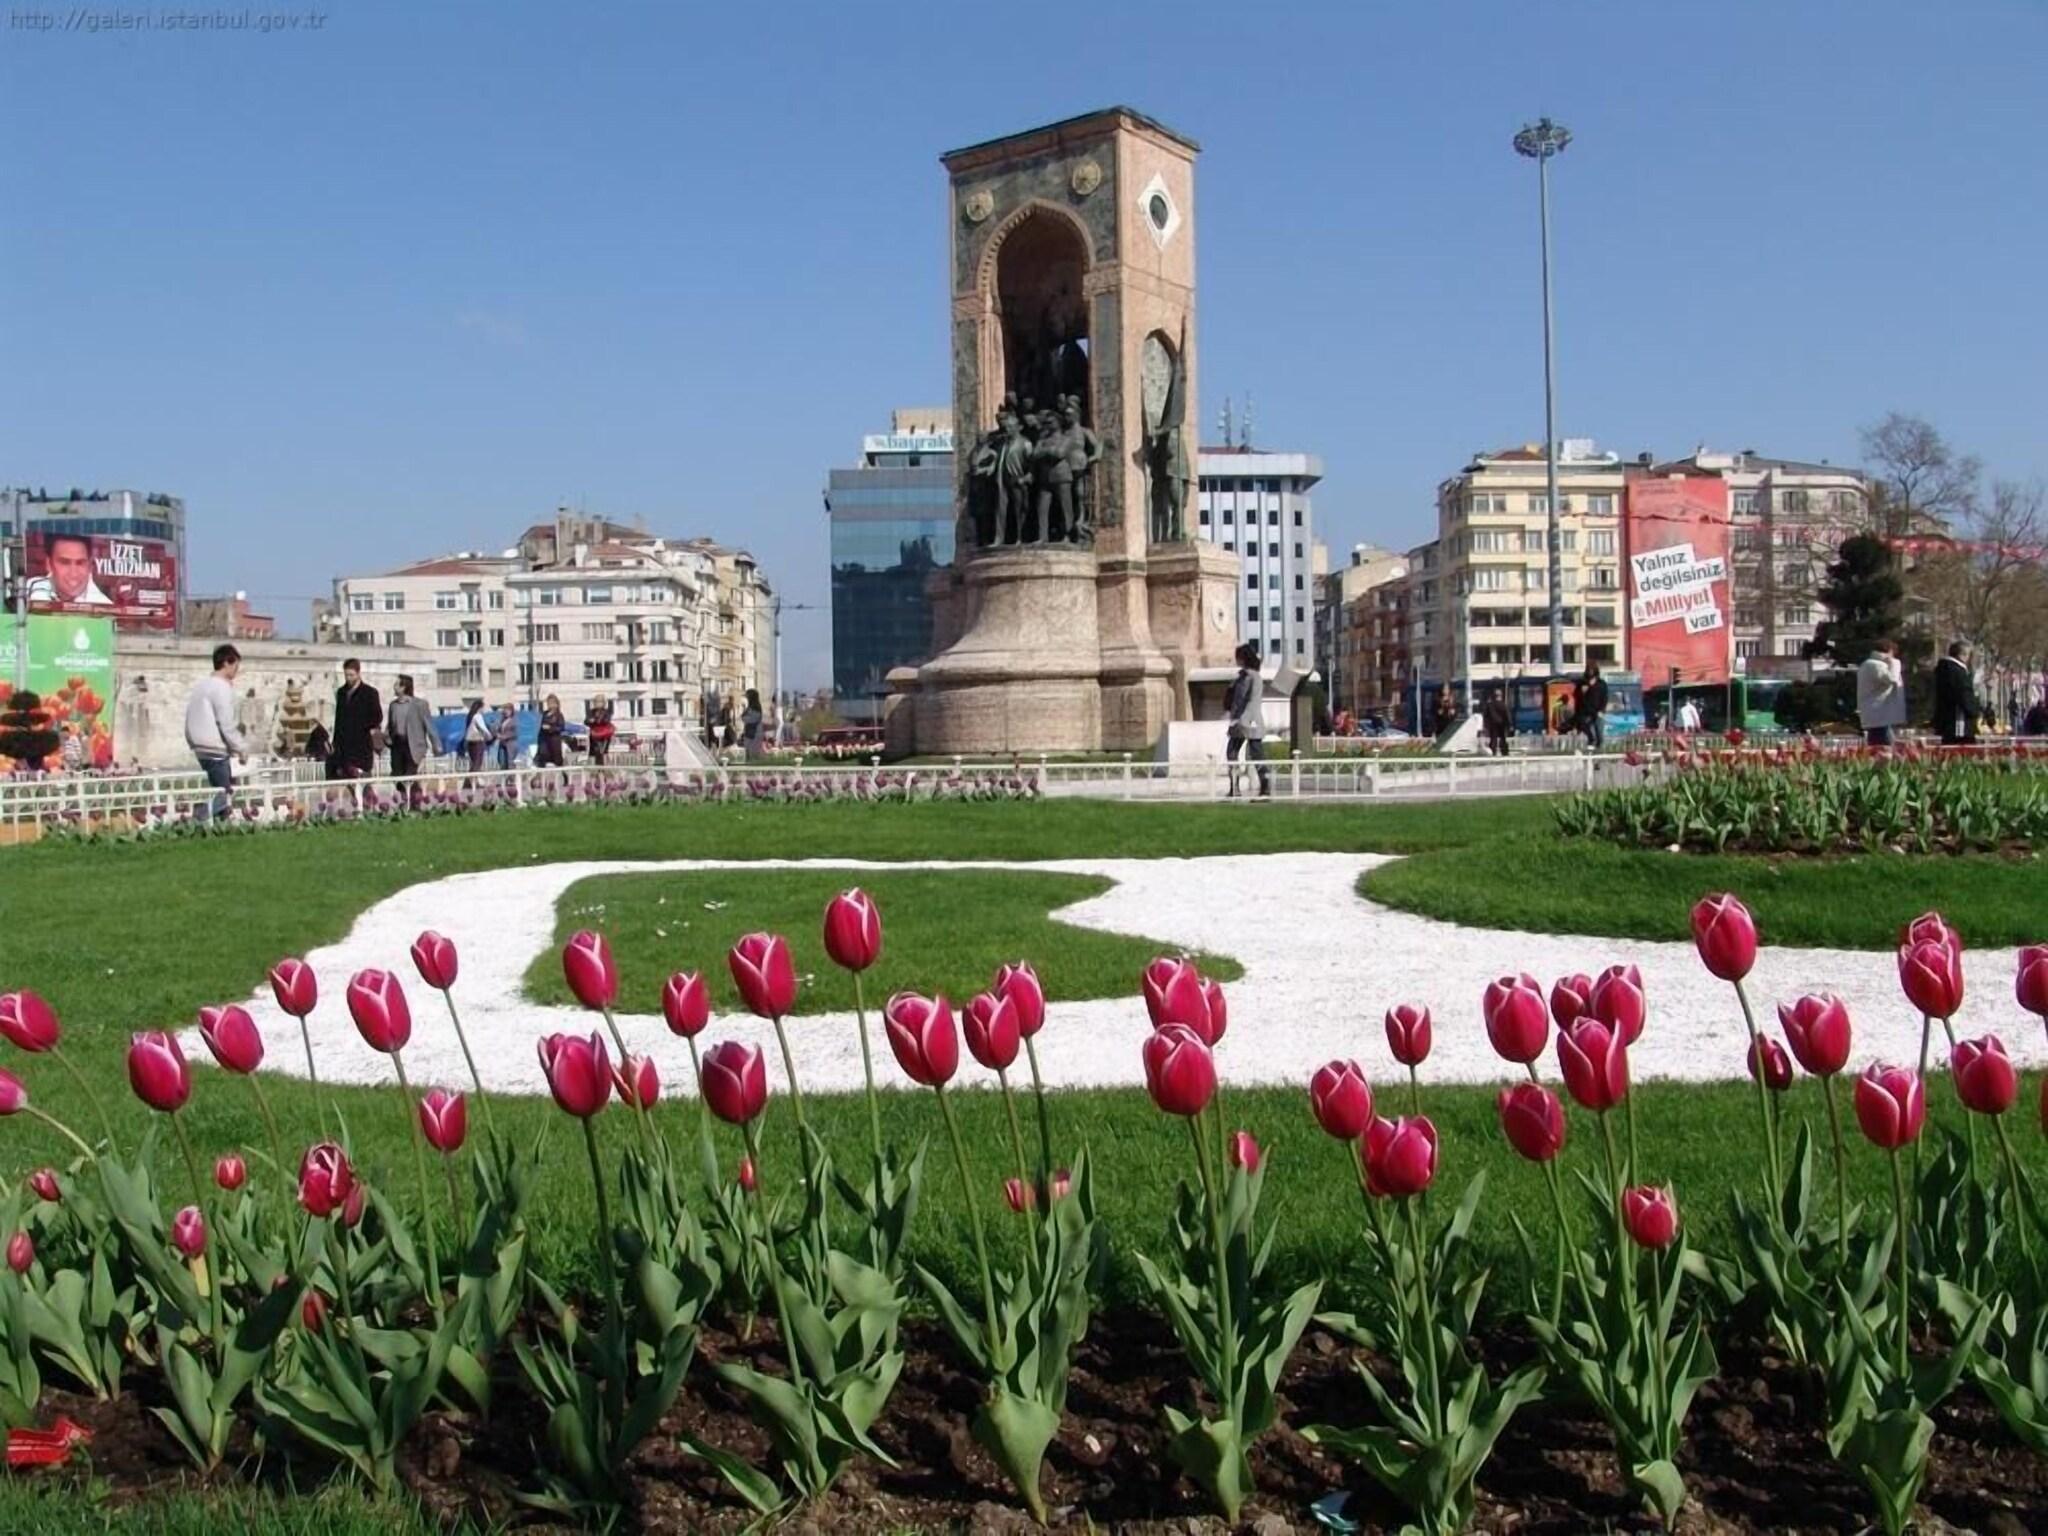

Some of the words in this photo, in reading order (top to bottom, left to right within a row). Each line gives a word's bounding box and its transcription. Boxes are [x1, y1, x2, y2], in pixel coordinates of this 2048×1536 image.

[1635, 552, 1687, 573] Yalnız
[1640, 563, 1722, 592] değilsiniz
[1645, 587, 1710, 617] Milliyet
[1690, 612, 1717, 629] var
